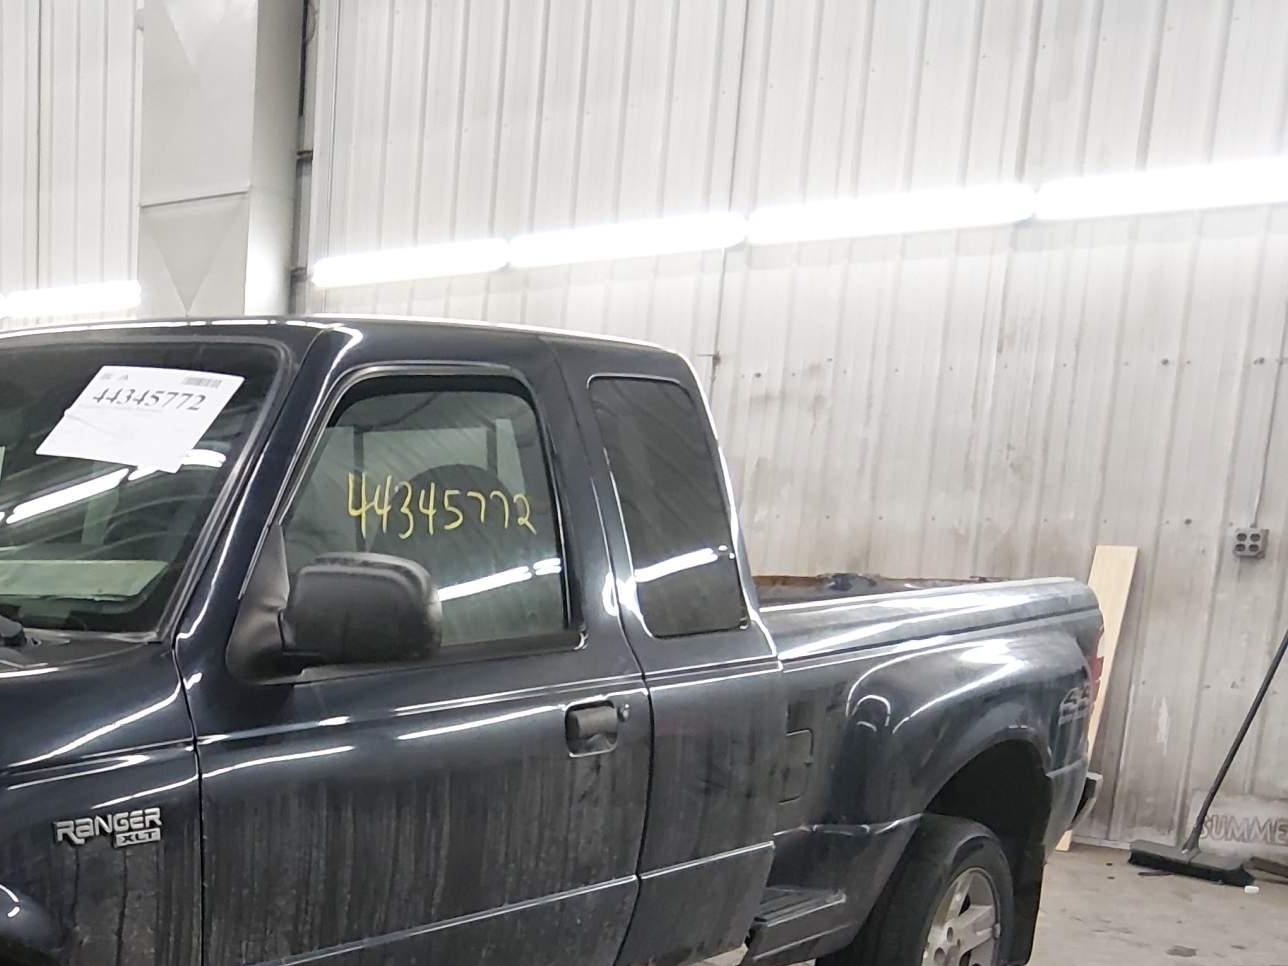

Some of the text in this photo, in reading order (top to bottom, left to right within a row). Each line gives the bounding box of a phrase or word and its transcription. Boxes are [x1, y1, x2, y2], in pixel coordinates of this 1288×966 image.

[93, 388, 206, 410] 44345772
[348, 471, 537, 540] 44345772
[54, 807, 162, 845] RANGER
[119, 830, 157, 845] XLT
